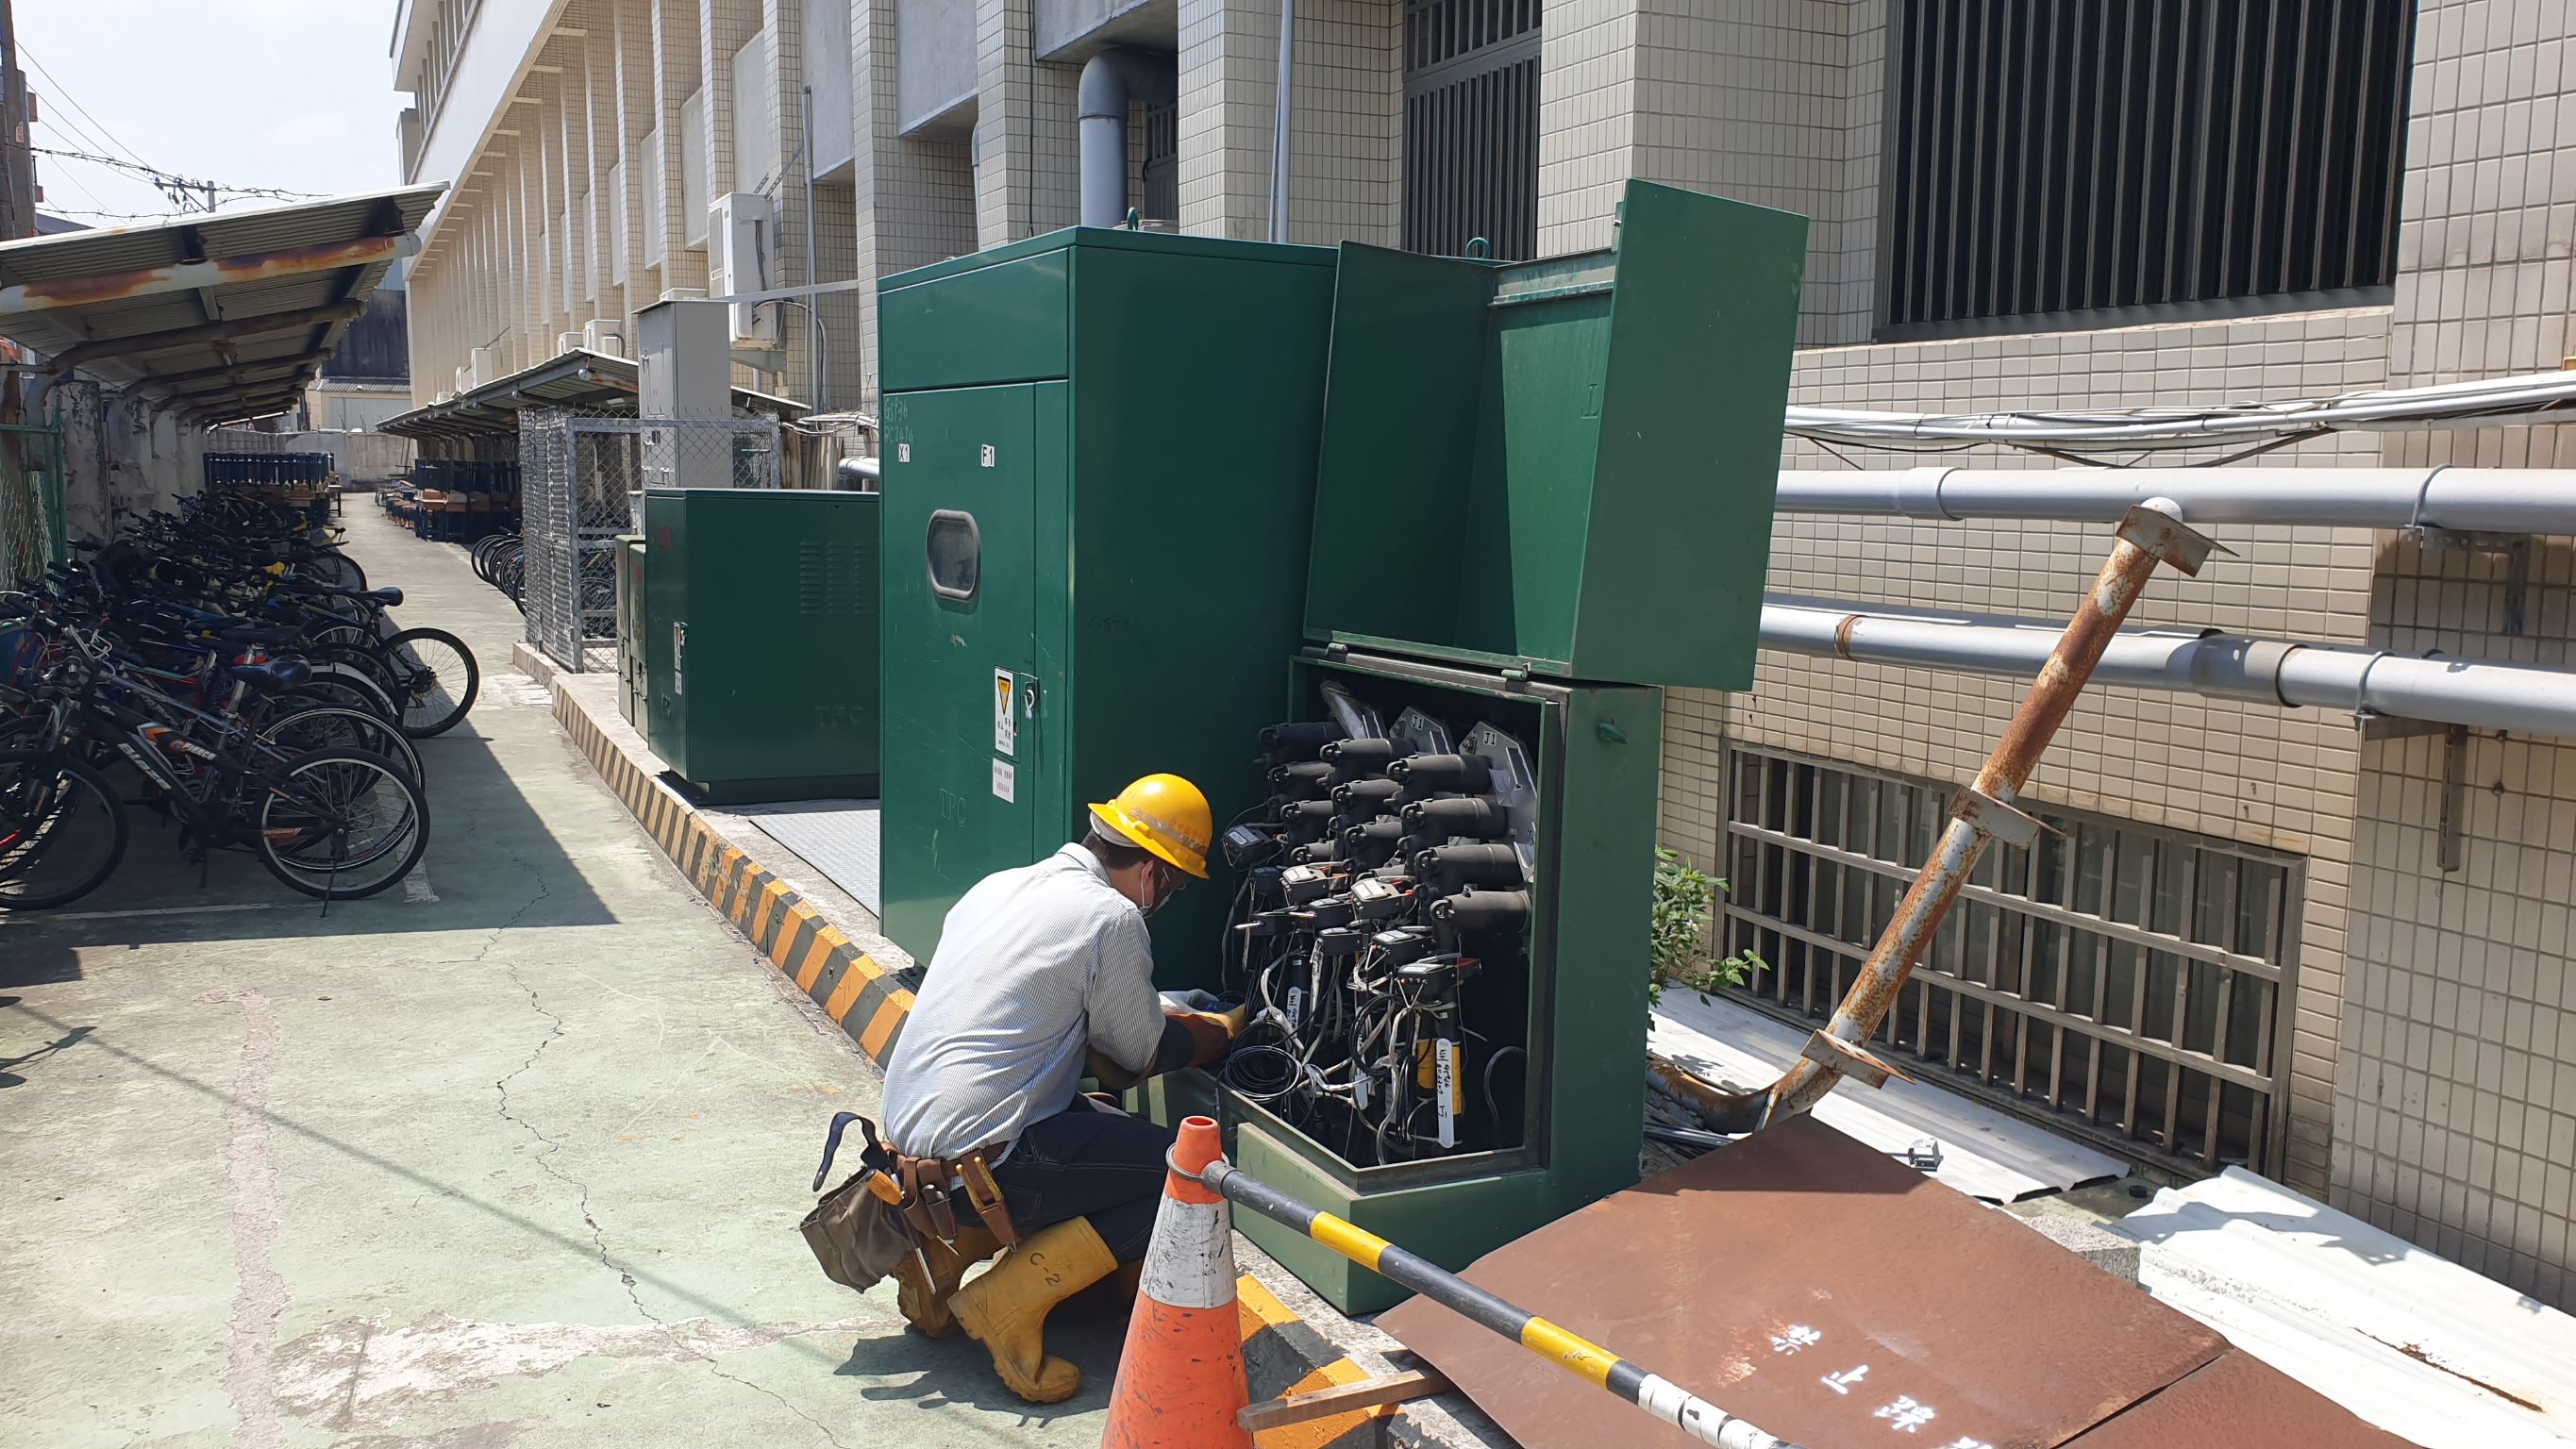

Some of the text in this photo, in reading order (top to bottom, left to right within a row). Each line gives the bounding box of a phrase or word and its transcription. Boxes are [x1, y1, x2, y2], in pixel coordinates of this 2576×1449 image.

[899, 444, 910, 461] X1
[982, 446, 994, 466] F1
[1412, 715, 1423, 730] J1
[1483, 732, 1497, 745] J1
[939, 787, 965, 827] TPC
